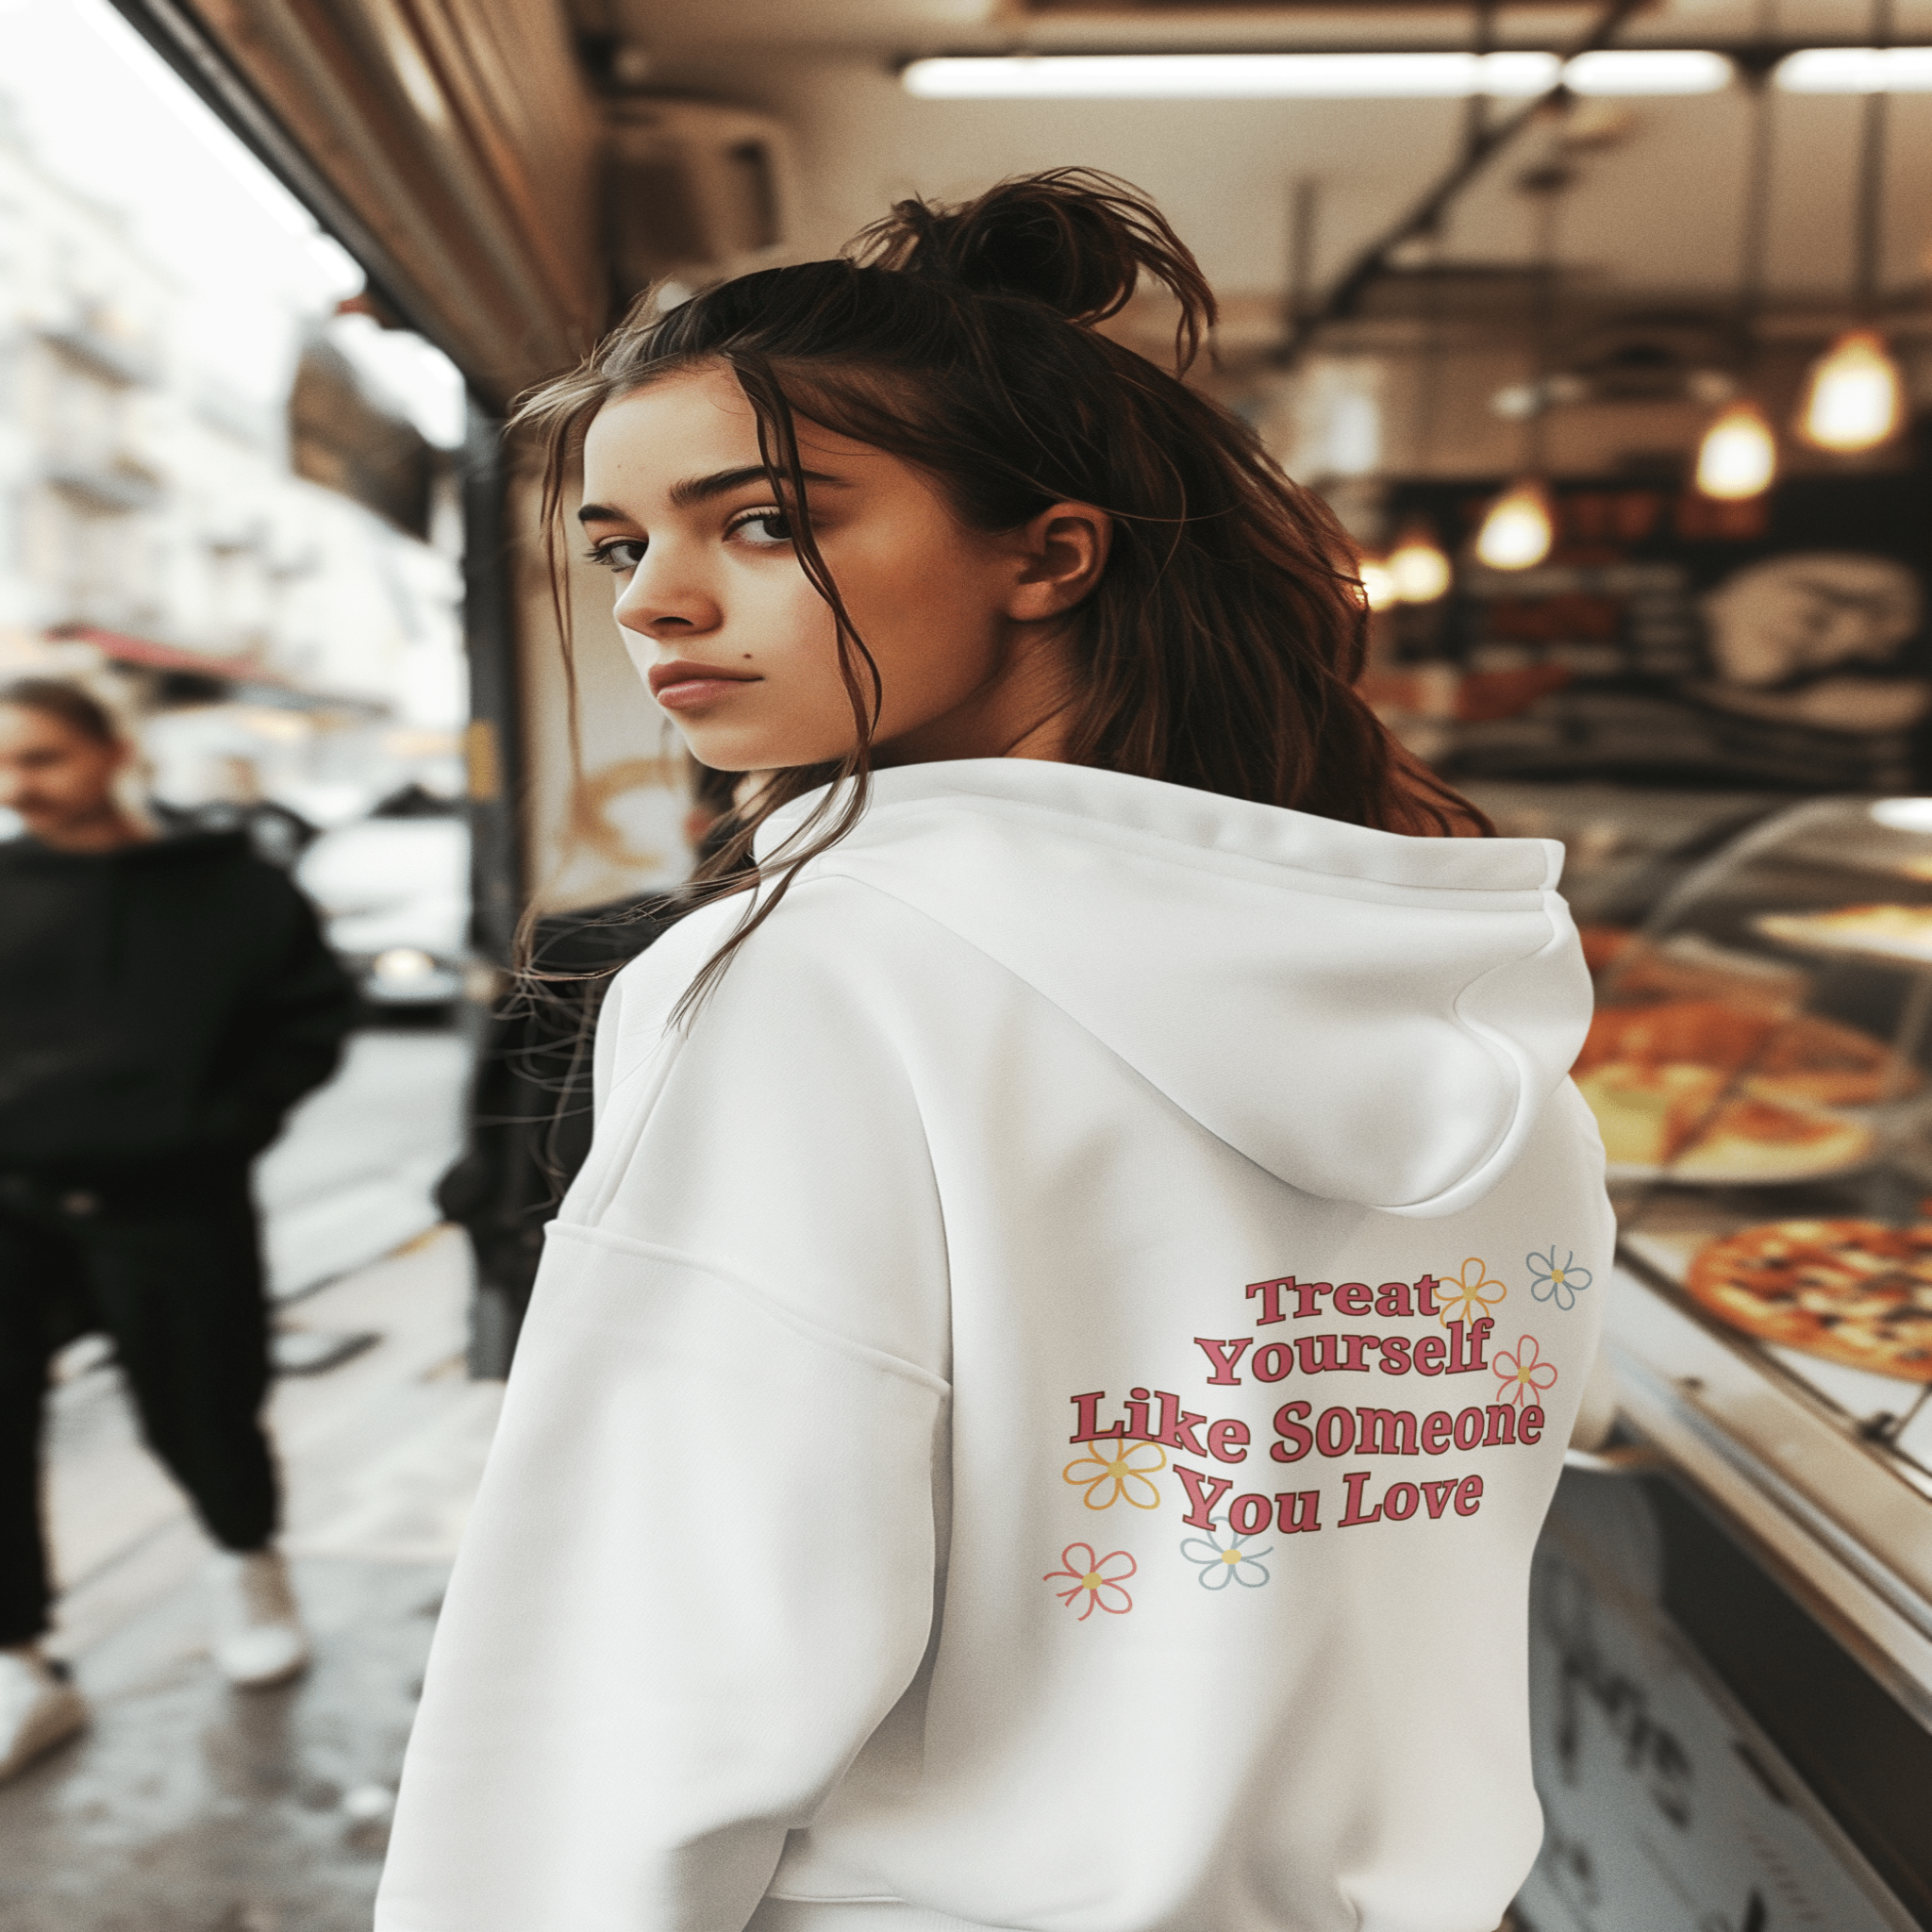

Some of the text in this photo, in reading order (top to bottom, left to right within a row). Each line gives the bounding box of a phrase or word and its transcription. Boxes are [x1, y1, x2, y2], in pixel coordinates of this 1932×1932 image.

[1245, 1274, 1441, 1327] Treat
[1194, 1318, 1495, 1386] Yourself
[1070, 1388, 1546, 1464] Like Someone
[1173, 1464, 1484, 1536] You Love
